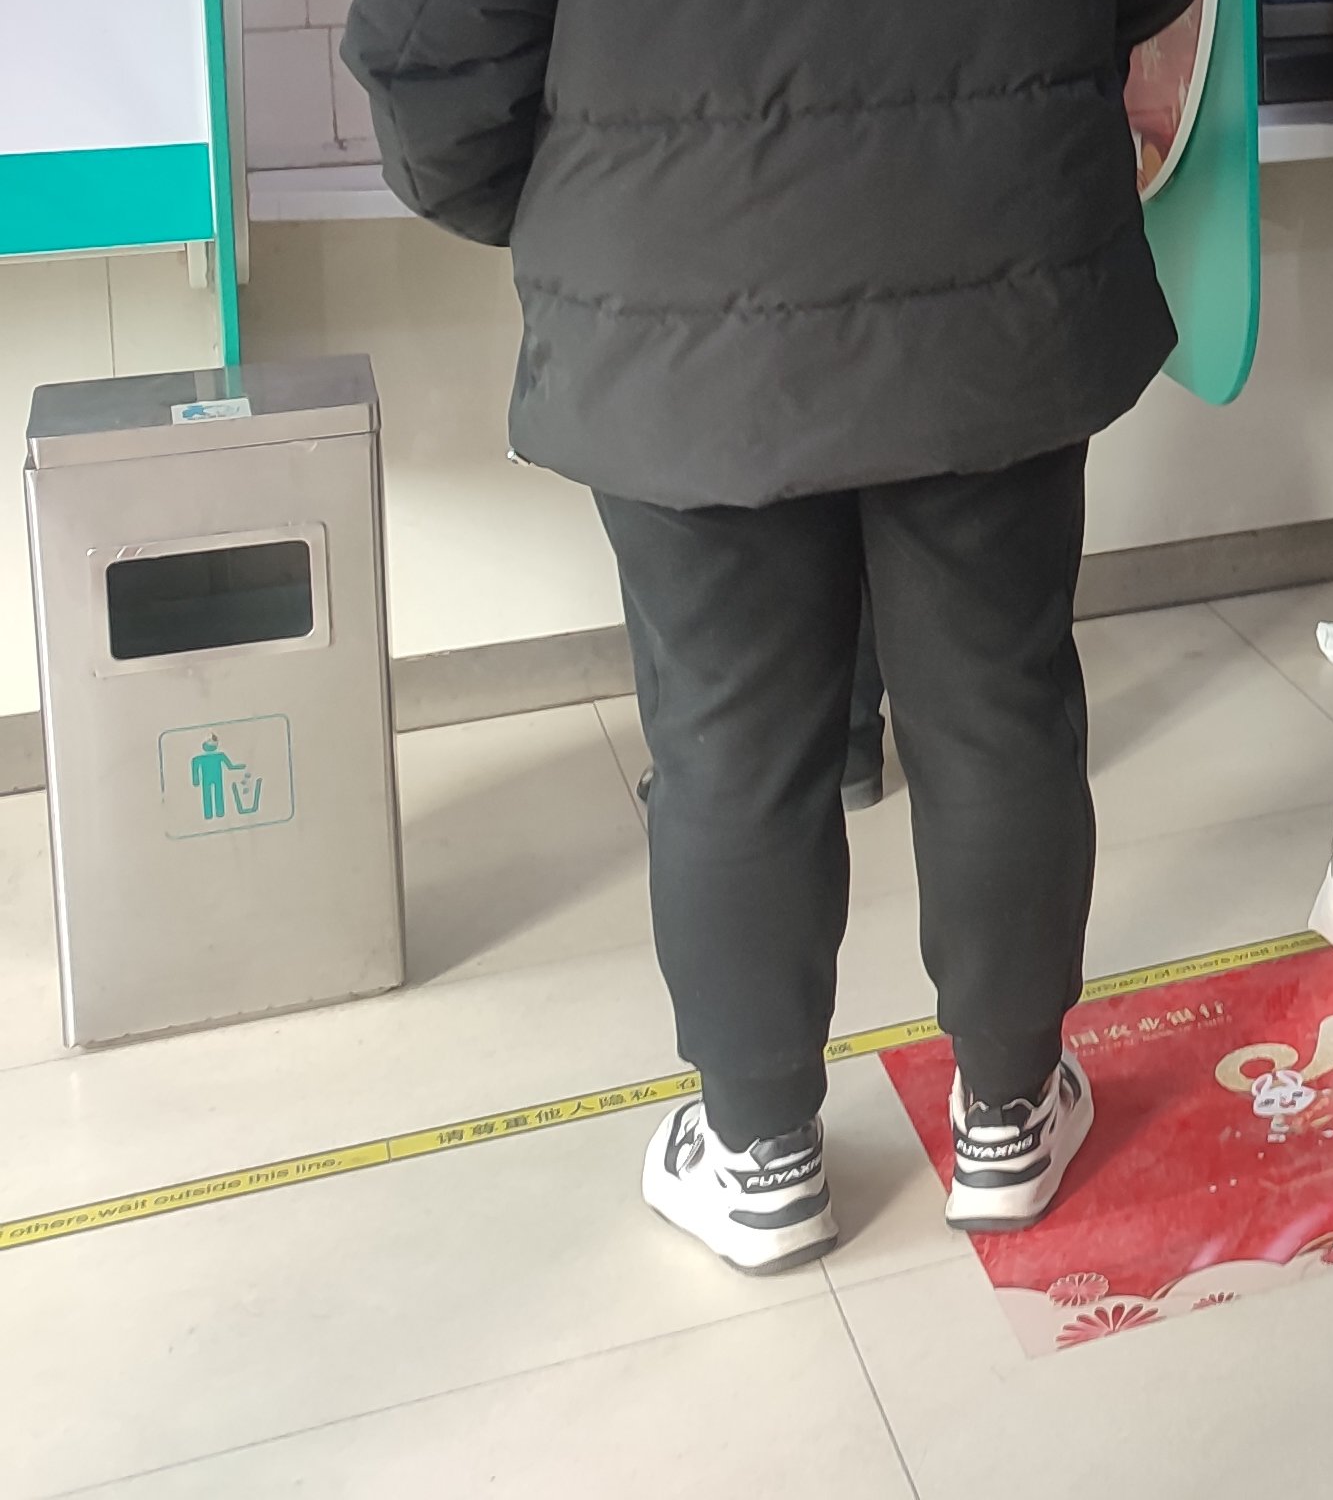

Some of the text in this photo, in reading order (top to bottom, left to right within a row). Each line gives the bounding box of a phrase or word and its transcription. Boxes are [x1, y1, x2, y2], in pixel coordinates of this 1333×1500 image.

[436, 1085, 658, 1145] 请尊重他人隐私
[153, 1178, 242, 1206] outside
[249, 1166, 290, 1185] this
